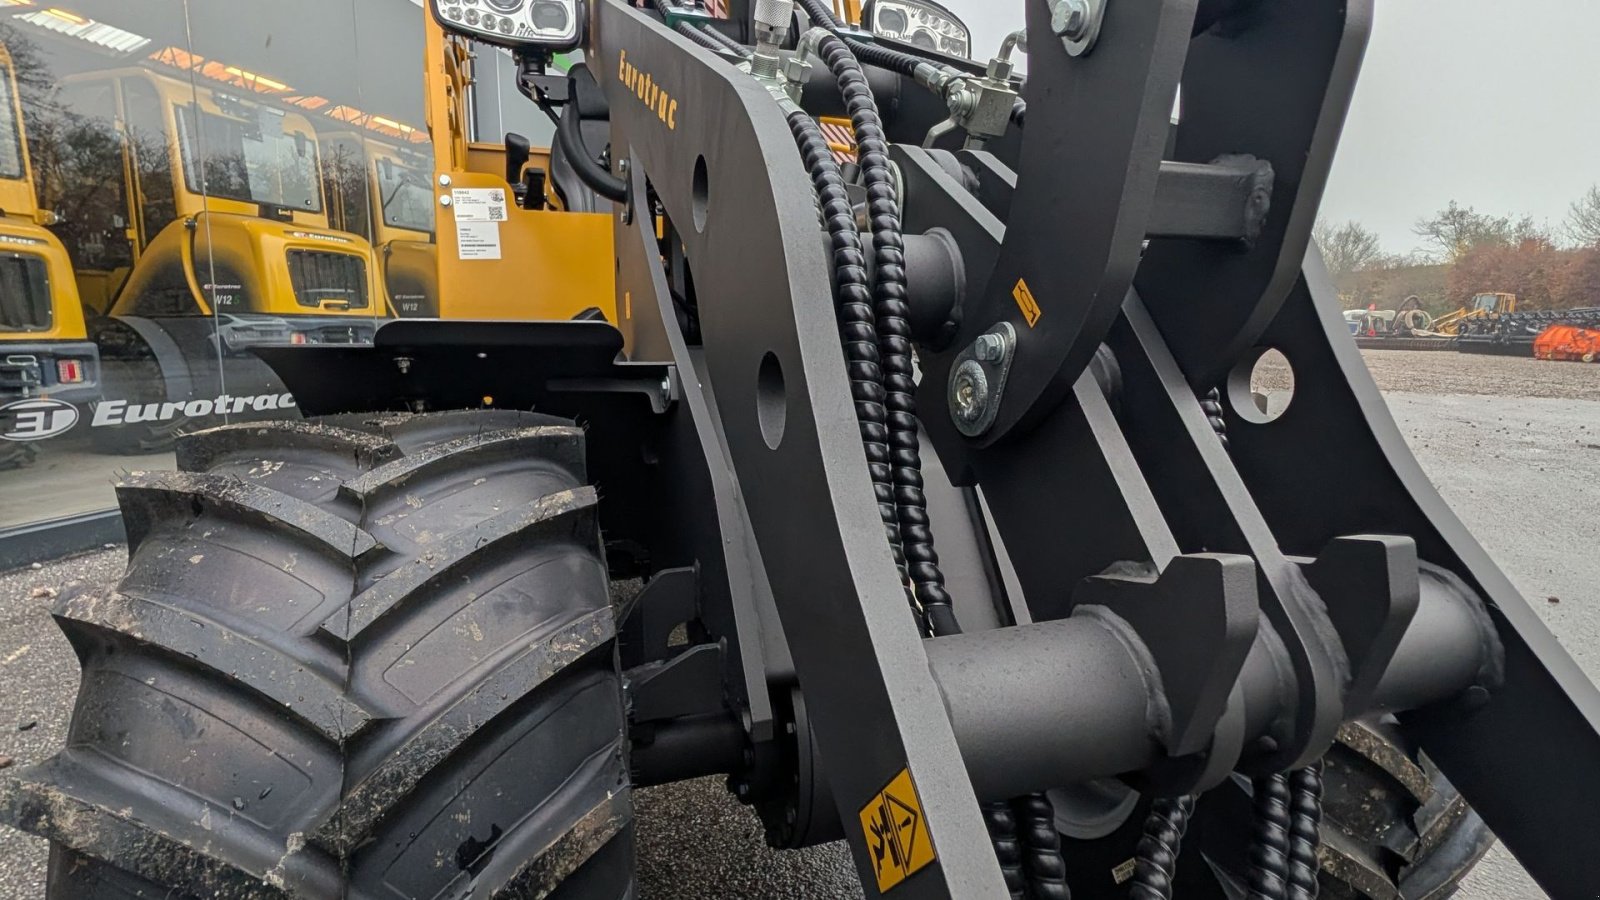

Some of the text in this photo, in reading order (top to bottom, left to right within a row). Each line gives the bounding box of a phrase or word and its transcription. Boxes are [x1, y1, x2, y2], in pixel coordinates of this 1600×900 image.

[619, 48, 677, 130] Eurotrac
[402, 302, 419, 312] W12
[91, 392, 296, 427] Eurotrac
